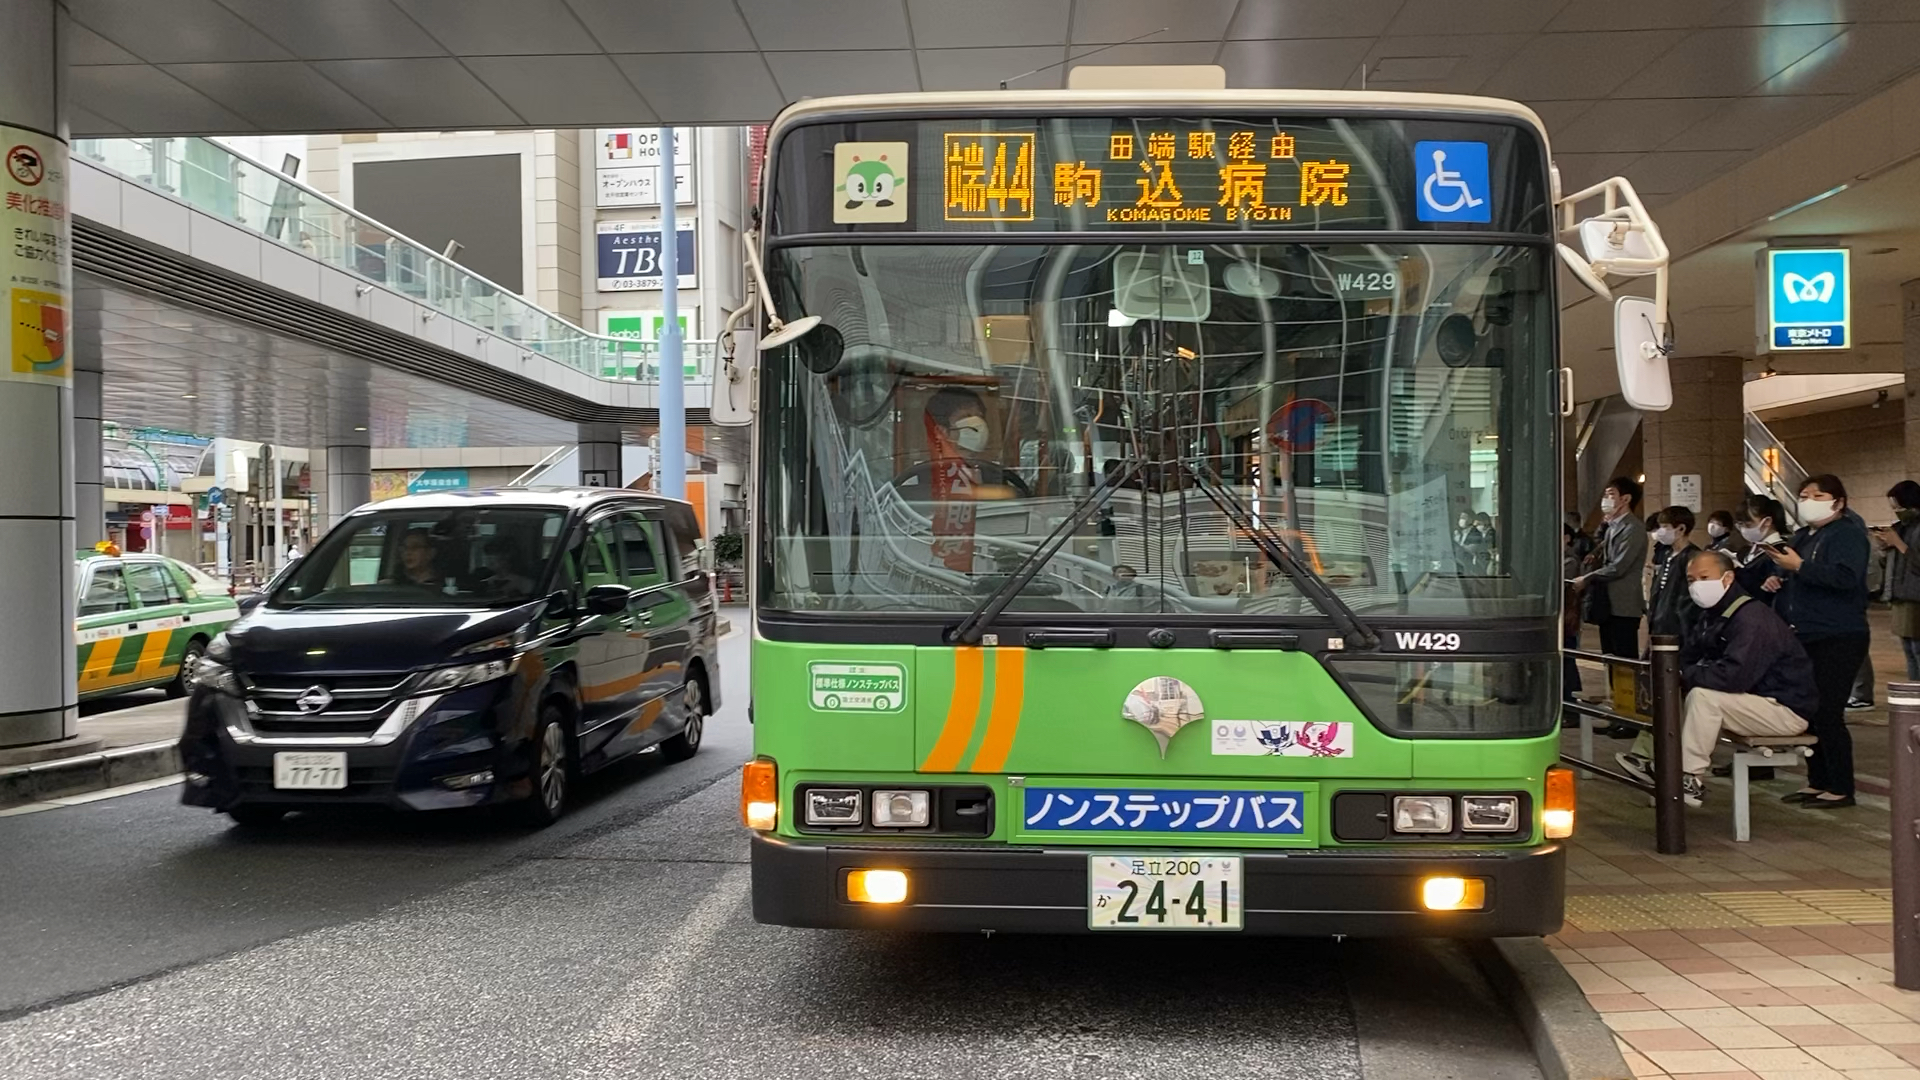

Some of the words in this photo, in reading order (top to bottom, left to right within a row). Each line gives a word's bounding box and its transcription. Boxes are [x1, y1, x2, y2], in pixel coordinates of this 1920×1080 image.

[639, 132, 679, 145] OPN
[1110, 132, 1295, 160] 田端駅経由
[639, 146, 679, 157] HOE
[602, 178, 651, 188] オープンハウス
[949, 142, 1030, 211] 端44
[1054, 160, 1349, 208] 駒込病院
[1107, 208, 1211, 221] KOMAGOME
[613, 235, 679, 245] Aesthe
[1338, 272, 1396, 291] W429
[1788, 328, 1832, 339] 東京メトロ
[1395, 632, 1460, 651] W429
[290, 766, 341, 786] 77-77
[1026, 792, 1302, 829] ノンステップバス
[1131, 861, 1201, 876] 足立200
[1097, 894, 1111, 908] か
[1117, 880, 1229, 923] 24-41
